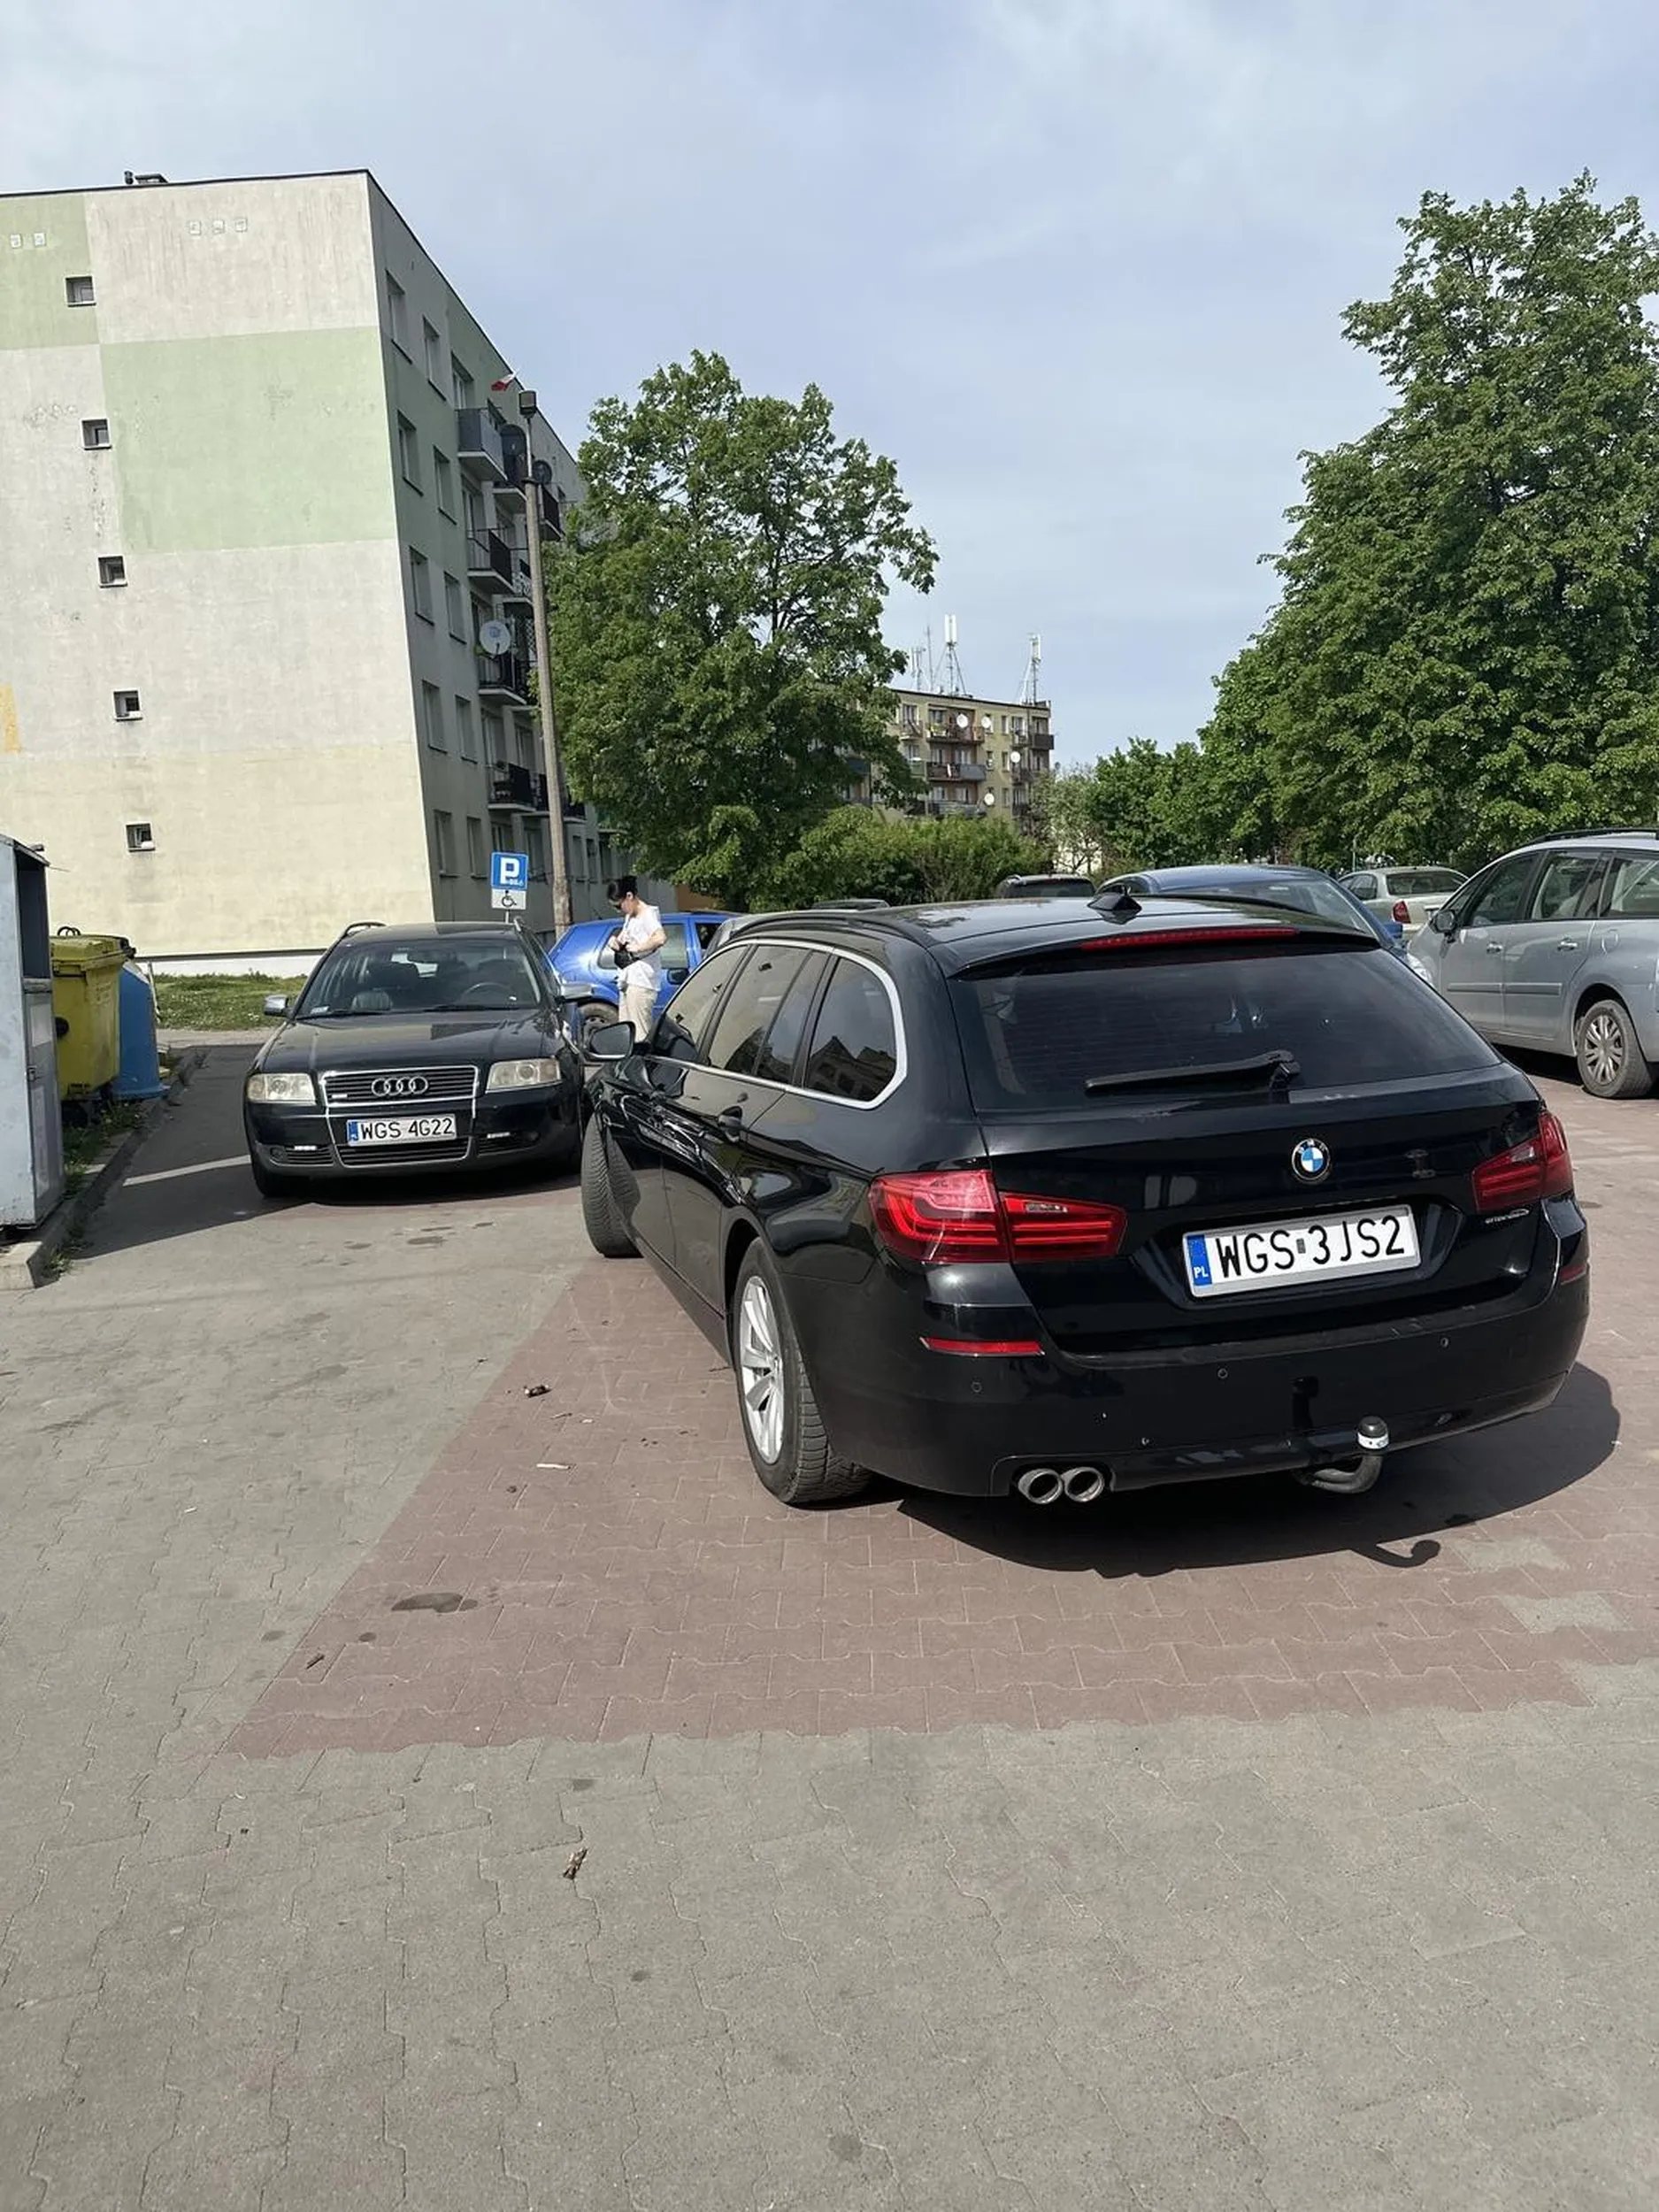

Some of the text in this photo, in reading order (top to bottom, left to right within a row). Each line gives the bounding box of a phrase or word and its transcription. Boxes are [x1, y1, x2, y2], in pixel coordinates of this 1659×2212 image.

[500, 857, 520, 884] P
[361, 1121, 402, 1140] WGS
[408, 1118, 453, 1136] 4G22
[1216, 1215, 1404, 1278] WGS 3JS2
[1194, 1266, 1210, 1279] PL
